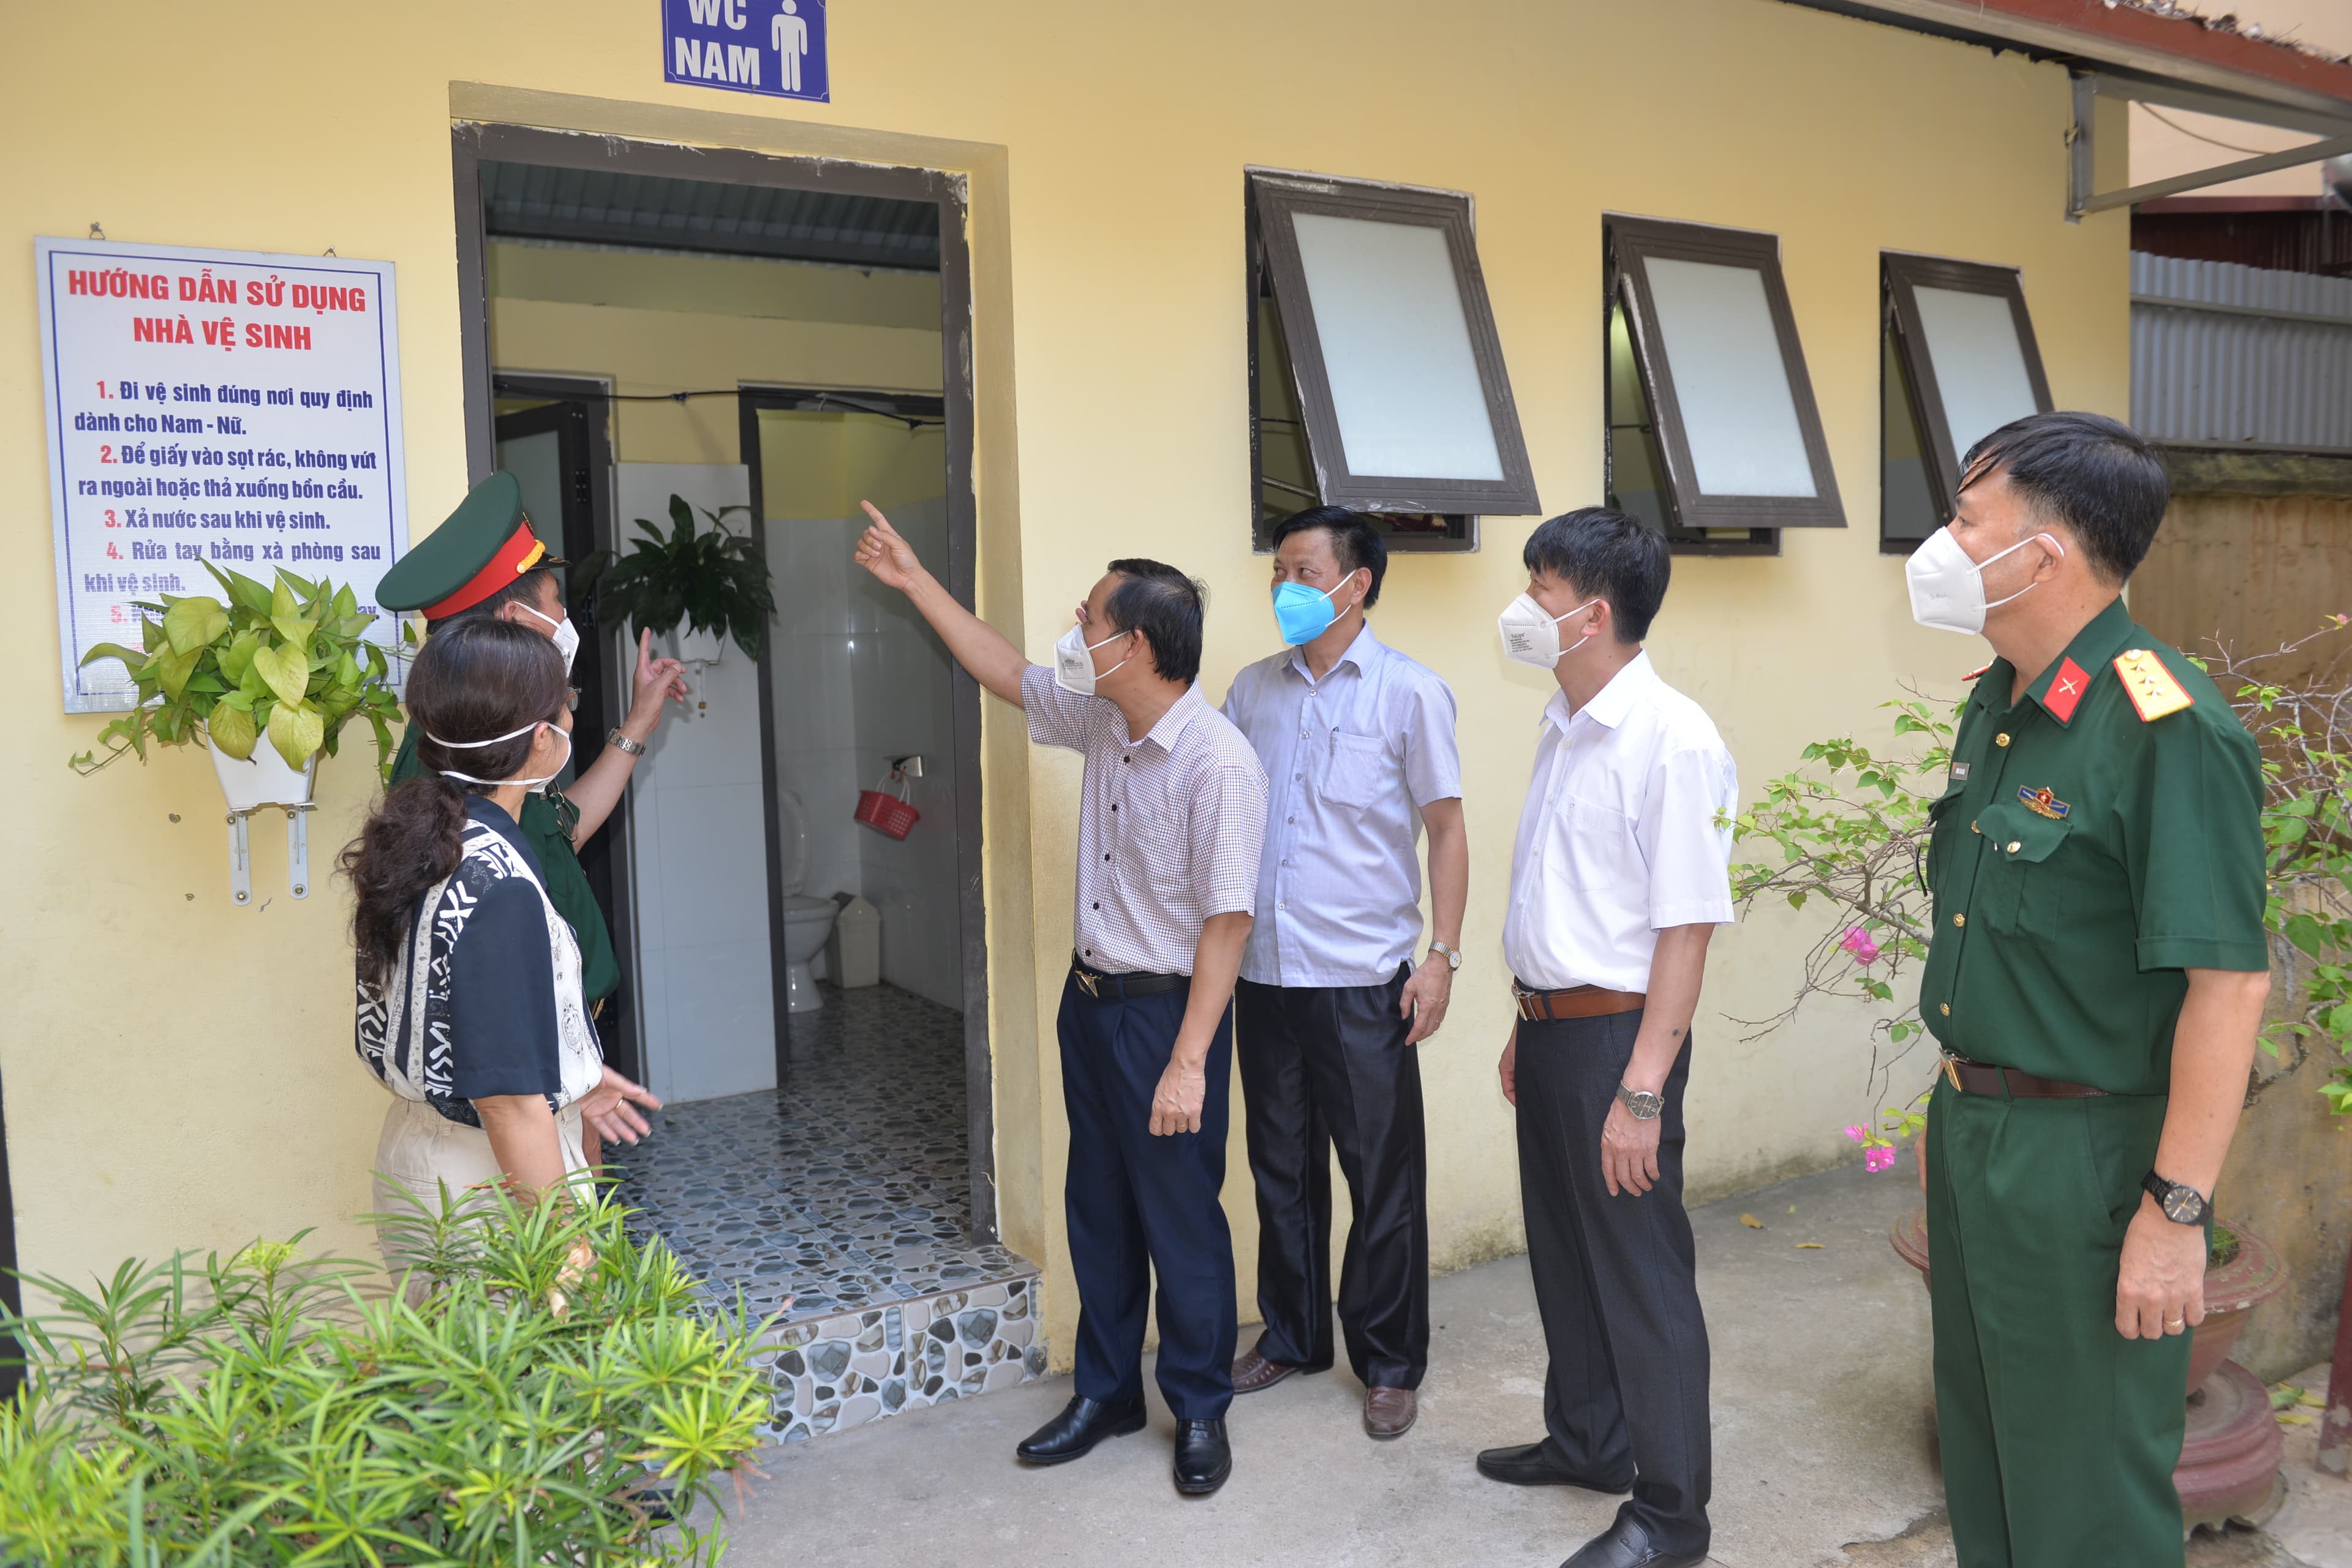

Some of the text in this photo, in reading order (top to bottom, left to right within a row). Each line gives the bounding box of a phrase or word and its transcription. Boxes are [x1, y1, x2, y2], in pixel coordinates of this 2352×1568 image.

[688, 0, 747, 31] WC
[675, 37, 760, 86] NAM
[69, 267, 366, 315] HƯỚNG DẪN SỬ DỤNG
[134, 314, 312, 352] NHÀ VỆ SINH
[97, 380, 372, 411] 1. Đi vệ sinh đúng nơi quy định
[75, 412, 121, 431] dành
[124, 413, 157, 432] cho
[161, 415, 203, 434] Nam
[217, 417, 247, 435] Nữ.
[100, 442, 377, 470] 2. Để giấy vào sọt rác, không vứt
[78, 477, 363, 500] ra ngoài hoặc thả xuống bồn cầu.
[105, 507, 330, 532] 3. Xả nước sau khi vệ sinh.
[107, 538, 381, 562] 4. Rửa tay bằng xà phòng sau
[85, 573, 186, 595] khi vệ sinh.
